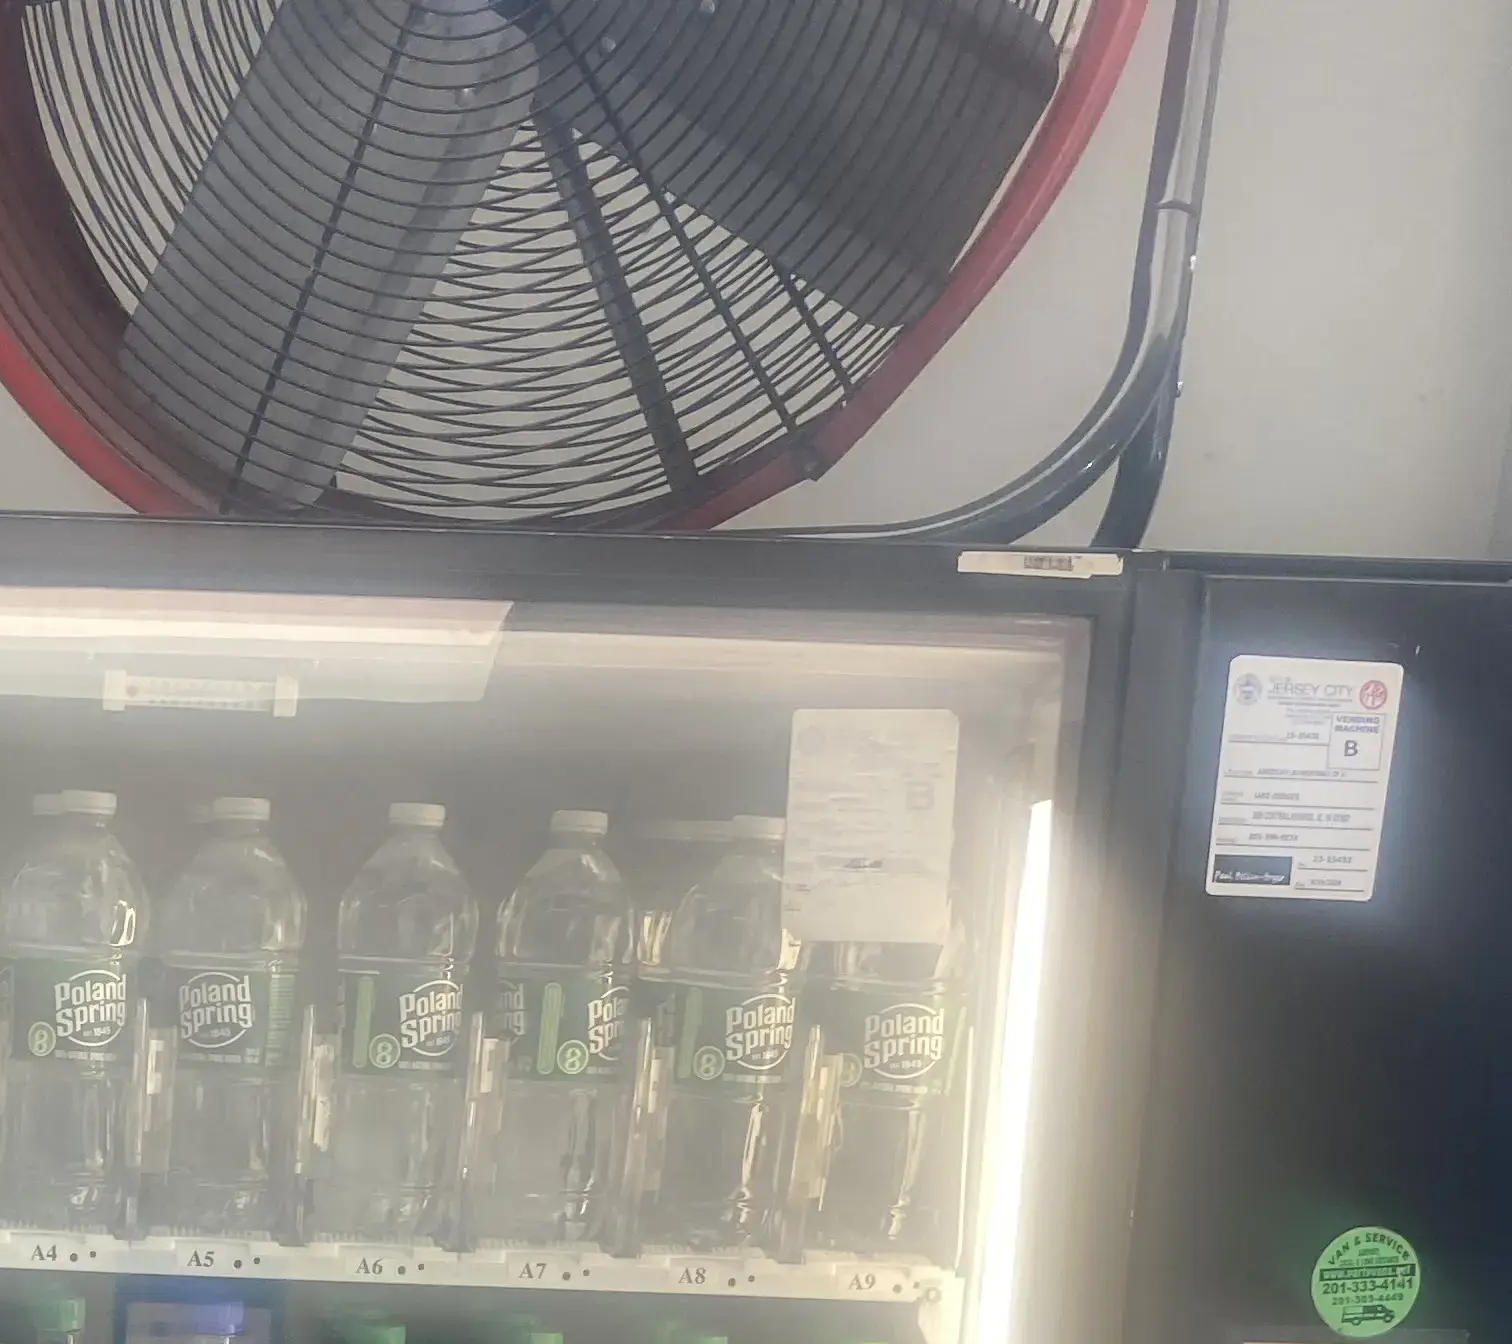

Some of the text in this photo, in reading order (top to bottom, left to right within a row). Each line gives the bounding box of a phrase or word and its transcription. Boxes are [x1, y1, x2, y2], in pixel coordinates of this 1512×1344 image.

[1269, 683, 1353, 696] JERSEY CITY
[1344, 740, 1358, 756] B
[55, 975, 126, 1009] Poland
[178, 976, 250, 1011] Poland
[400, 982, 462, 1018] Poland
[57, 1002, 126, 1036] Spring
[180, 1003, 253, 1039] Spring
[401, 1008, 462, 1048] Spring
[726, 998, 795, 1033] Poland
[865, 1011, 944, 1042] Poland
[727, 1025, 793, 1066] Spring
[864, 1033, 942, 1069] Spring
[31, 1245, 57, 1261] A4
[187, 1250, 215, 1267] A5
[356, 1258, 383, 1274] A6
[518, 1263, 546, 1280] A7
[678, 1268, 705, 1285] A8
[1323, 1277, 1413, 1294] 201-333-4141
